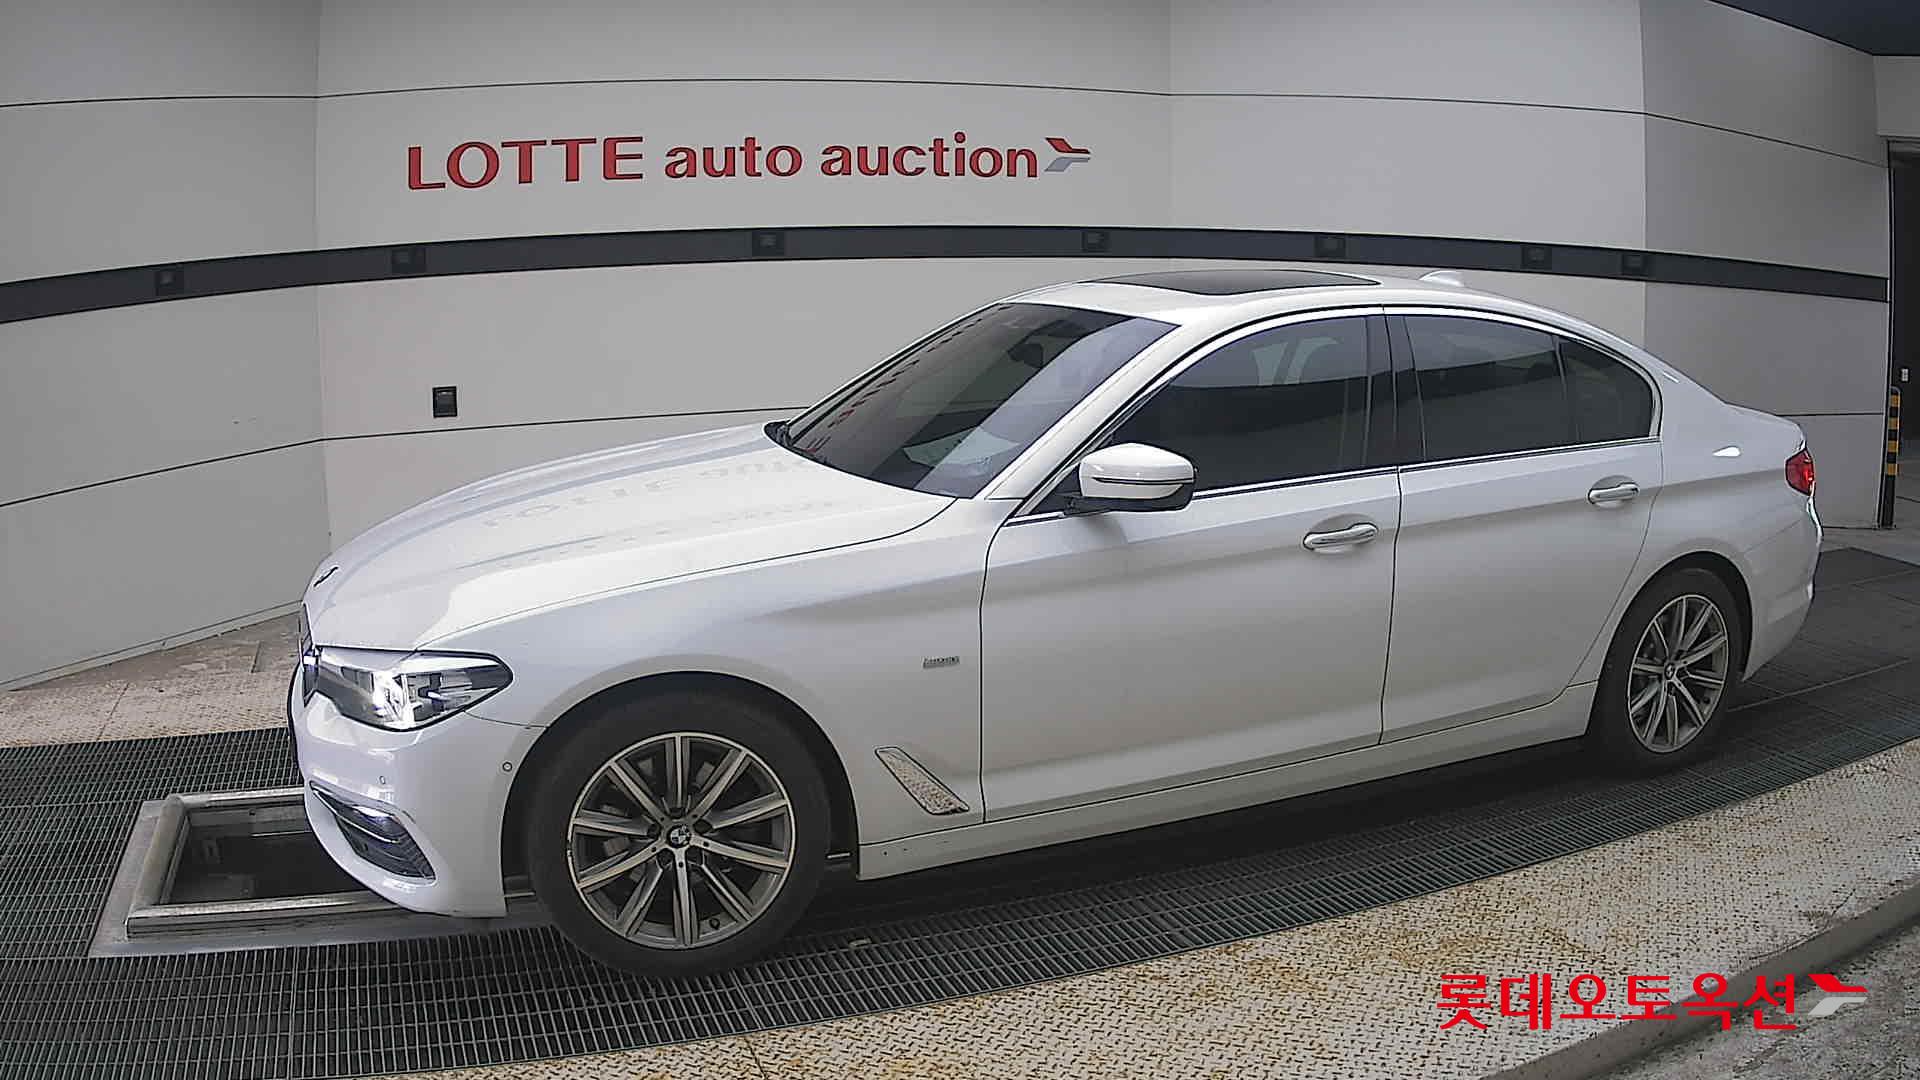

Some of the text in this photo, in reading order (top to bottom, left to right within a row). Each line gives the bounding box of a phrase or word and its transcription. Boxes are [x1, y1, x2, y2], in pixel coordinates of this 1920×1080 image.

[408, 132, 1039, 191] LOTTE auto auction
